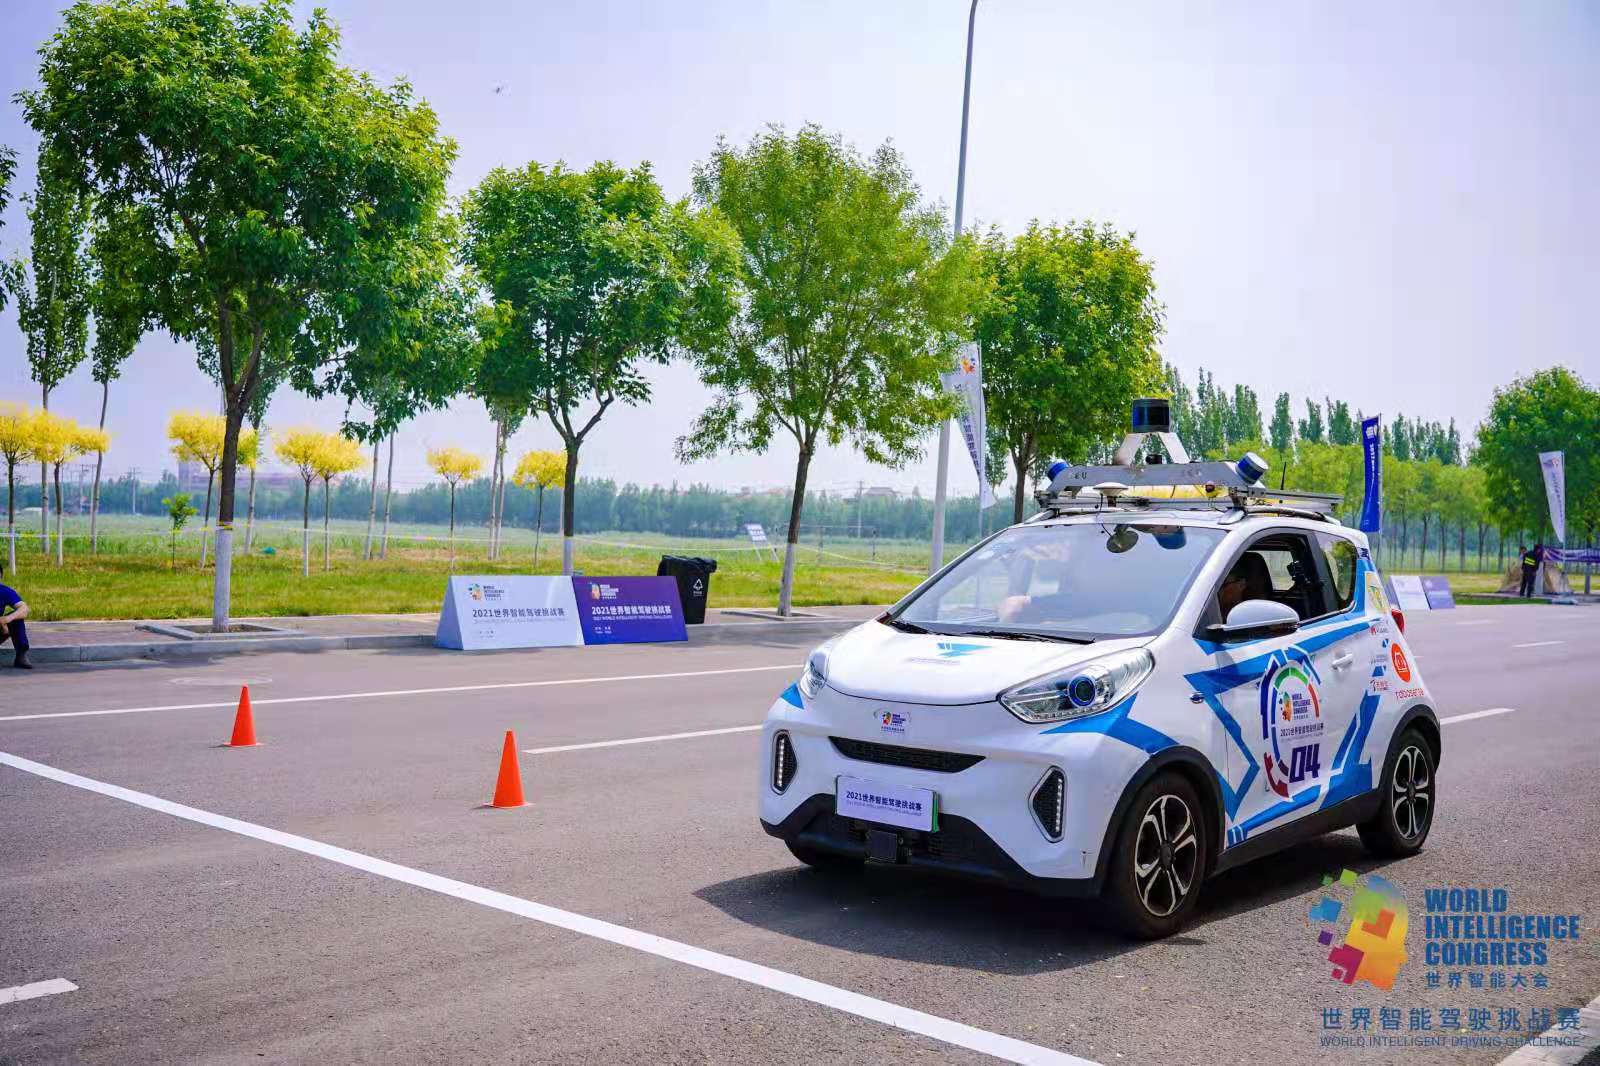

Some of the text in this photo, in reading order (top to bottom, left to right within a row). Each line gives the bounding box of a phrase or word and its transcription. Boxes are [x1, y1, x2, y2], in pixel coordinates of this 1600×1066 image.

[1289, 743, 1321, 783] 04
[846, 790, 922, 811] 2021世界智能驾驶挑战赛
